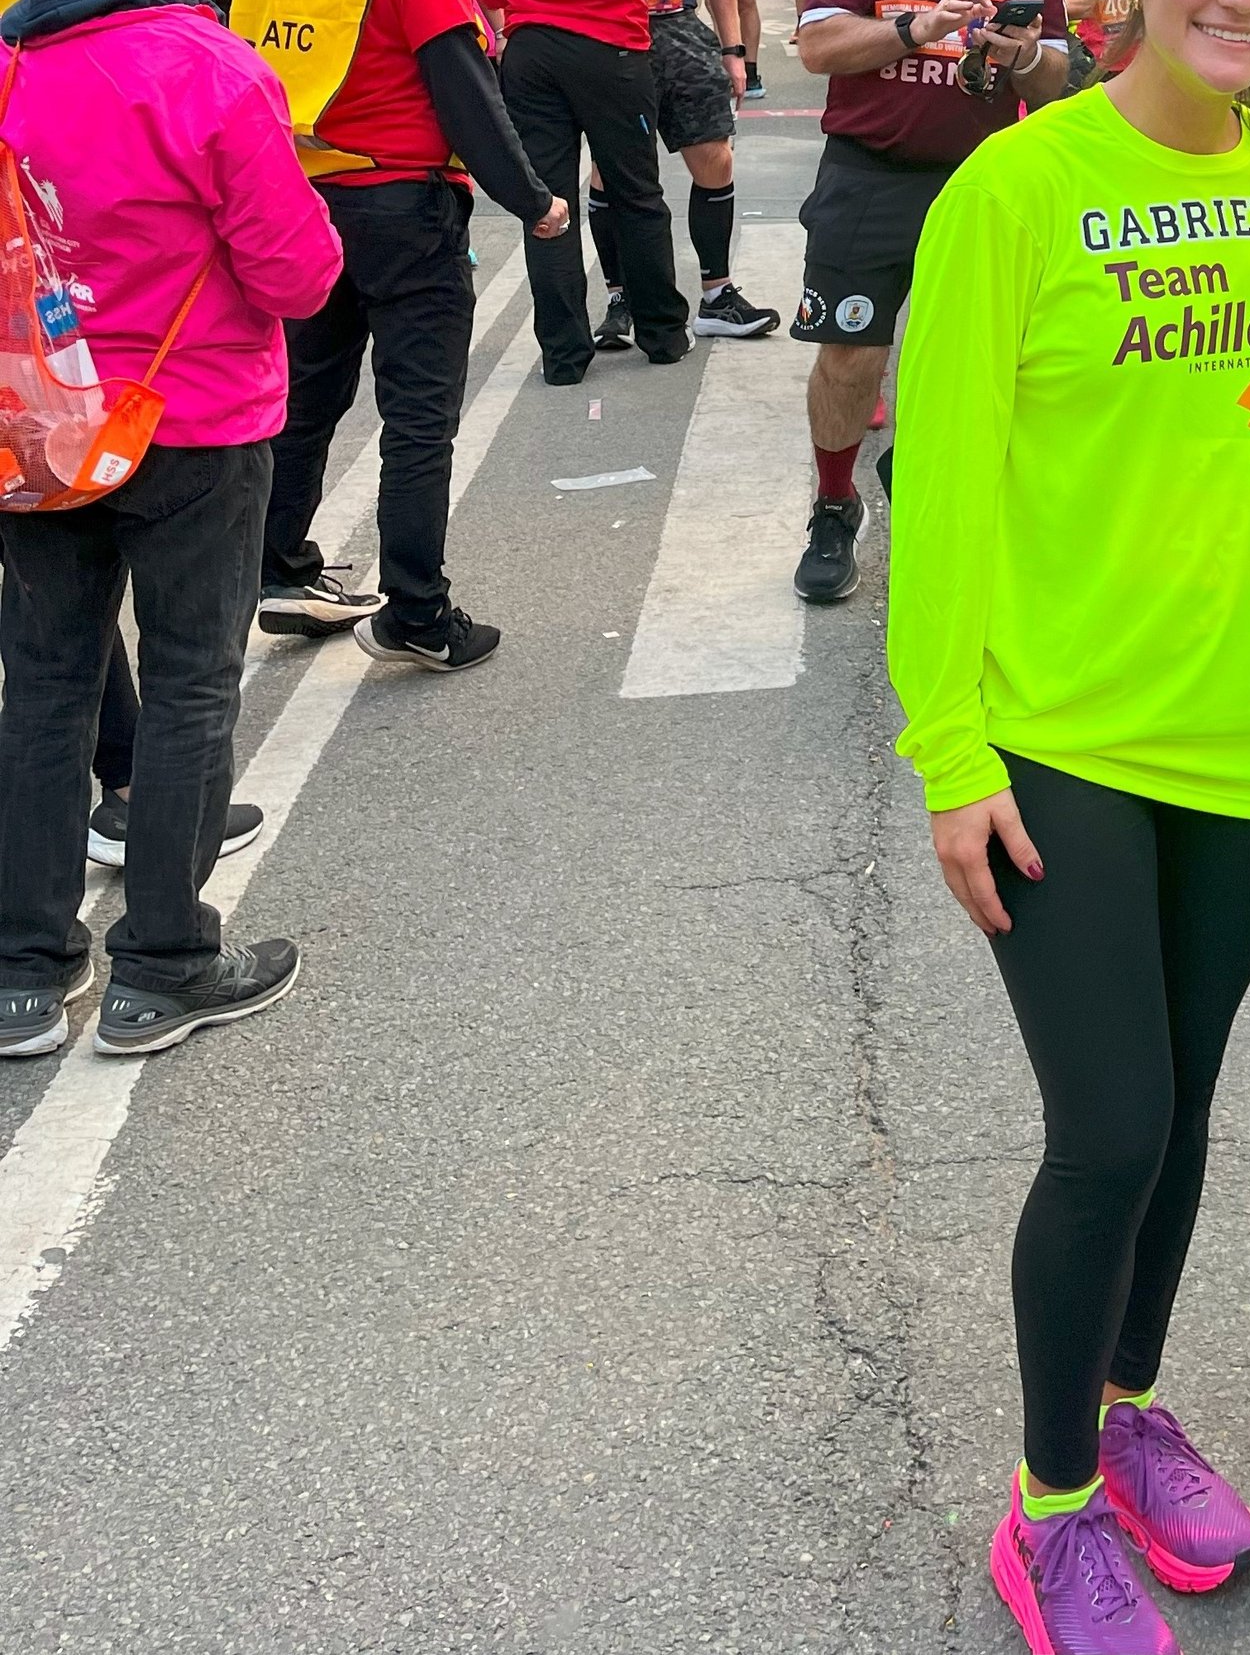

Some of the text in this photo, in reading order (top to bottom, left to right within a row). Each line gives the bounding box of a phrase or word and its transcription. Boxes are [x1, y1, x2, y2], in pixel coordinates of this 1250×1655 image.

[881, 4, 912, 12] MEMORIAL
[261, 20, 315, 52] ATC
[1105, 261, 1229, 303] Team
[805, 287, 819, 298] TCS
[814, 311, 827, 327] YORK
[101, 458, 120, 482] HSS
